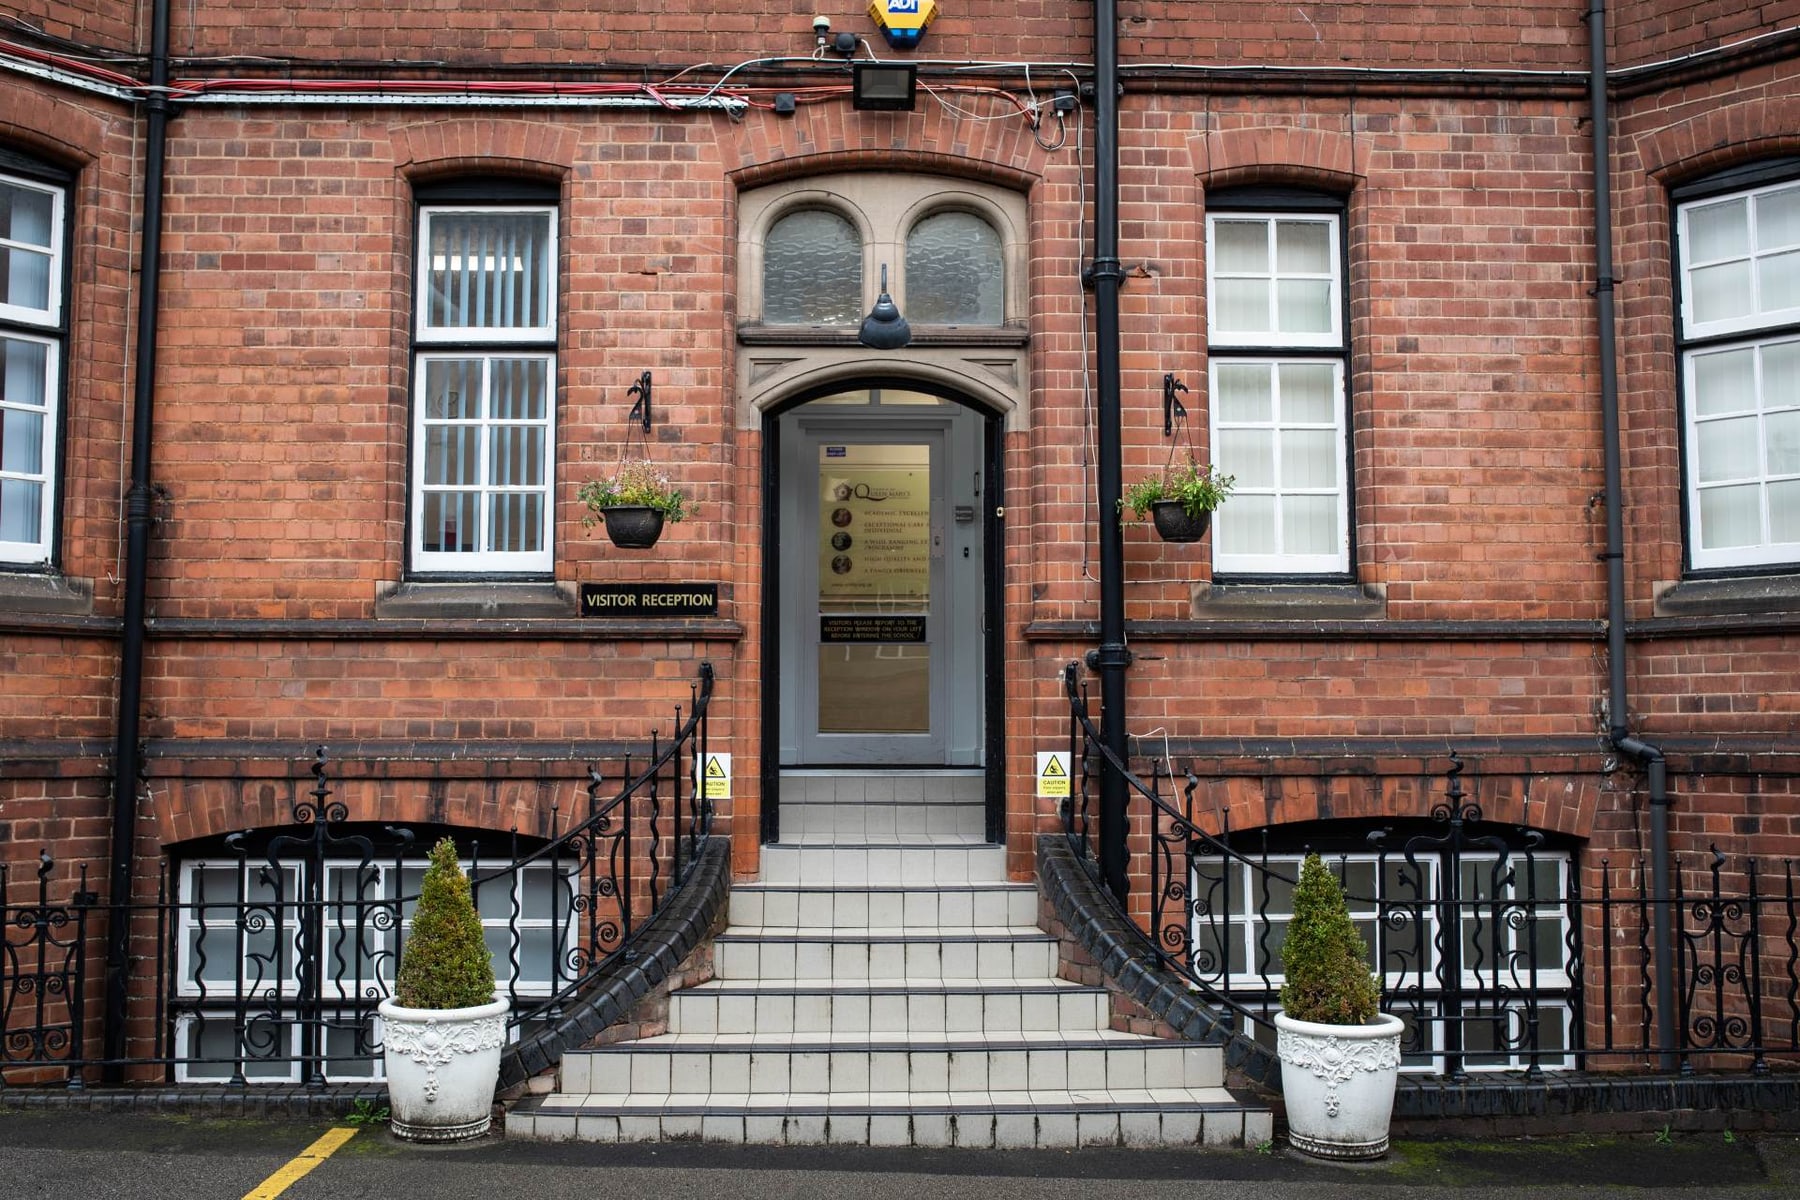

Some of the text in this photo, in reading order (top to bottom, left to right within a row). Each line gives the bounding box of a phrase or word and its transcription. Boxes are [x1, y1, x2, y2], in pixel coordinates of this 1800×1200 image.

[888, 0, 917, 9] ADT
[586, 594, 713, 606] VISITOR RECEPTION
